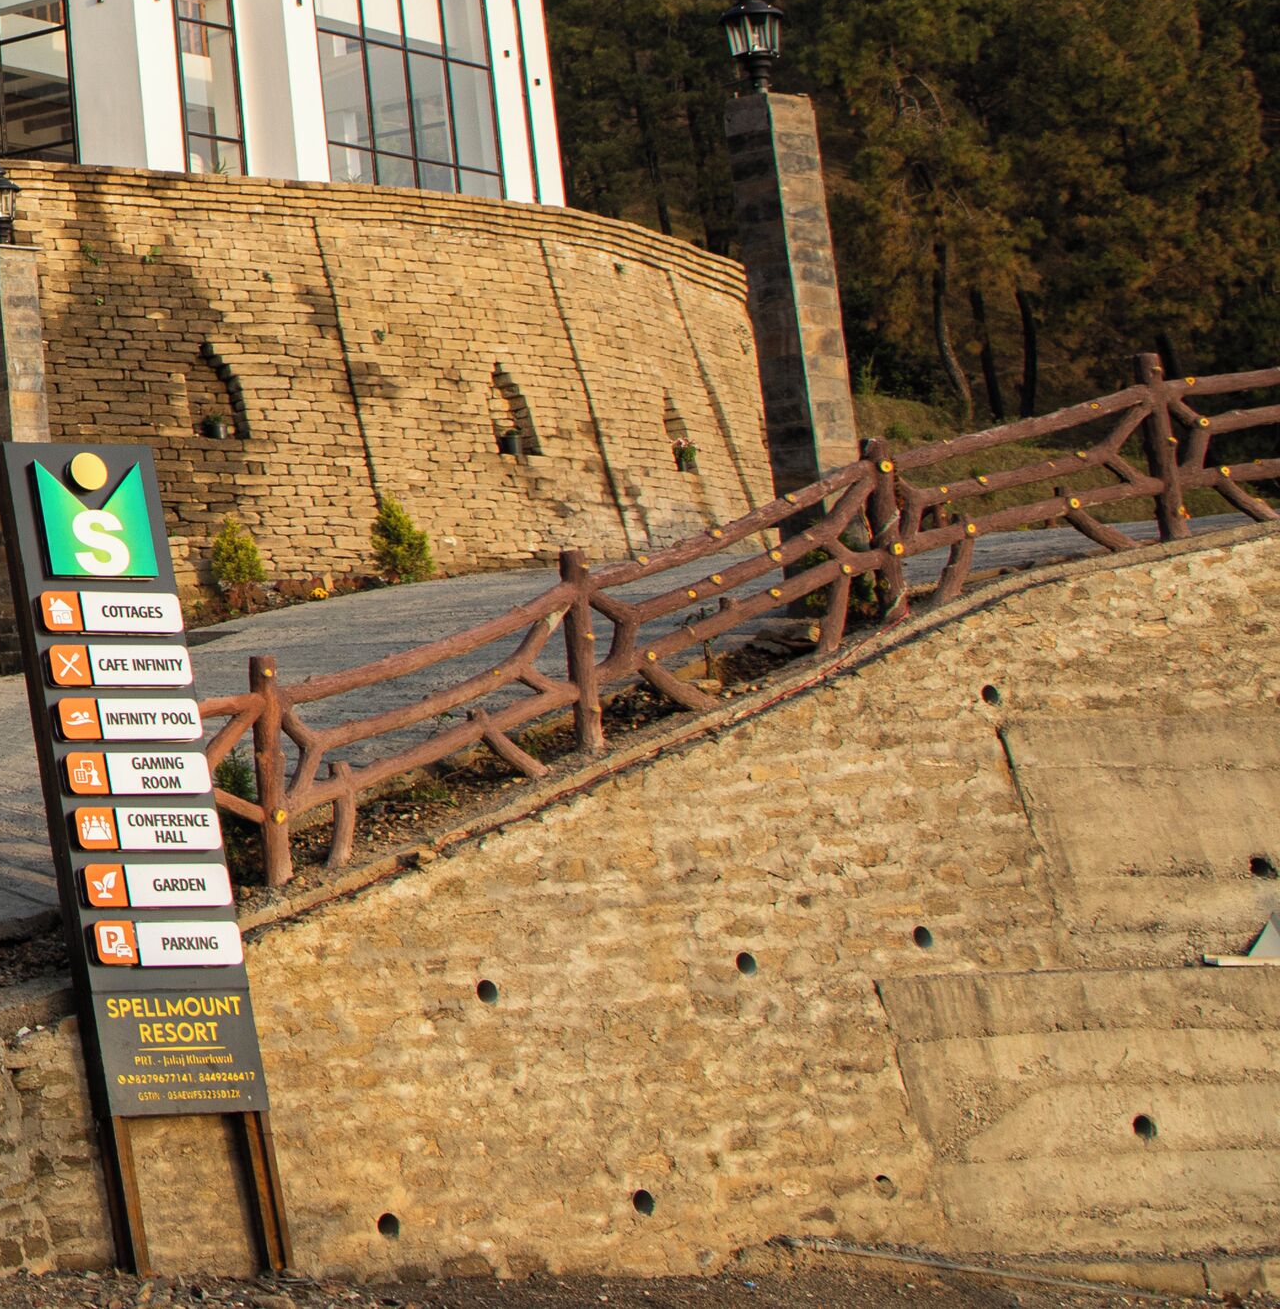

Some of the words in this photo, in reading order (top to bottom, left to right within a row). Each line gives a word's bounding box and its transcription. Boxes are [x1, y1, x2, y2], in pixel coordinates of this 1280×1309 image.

[72, 509, 130, 576] S
[101, 605, 163, 619] COTTAGES
[98, 658, 129, 671] CAFE
[132, 658, 183, 672] INFINITY
[105, 712, 157, 725] INFINITY
[161, 712, 196, 725] POOL
[131, 757, 184, 770] GAMING
[141, 776, 182, 789] ROOM
[127, 814, 210, 827] CONFERENCE
[155, 830, 188, 843] HALL
[152, 878, 207, 891] GARDEN
[161, 936, 219, 950] PARKING
[106, 996, 241, 1019] SPELLMOUNT
[138, 1022, 219, 1043] RESORT
